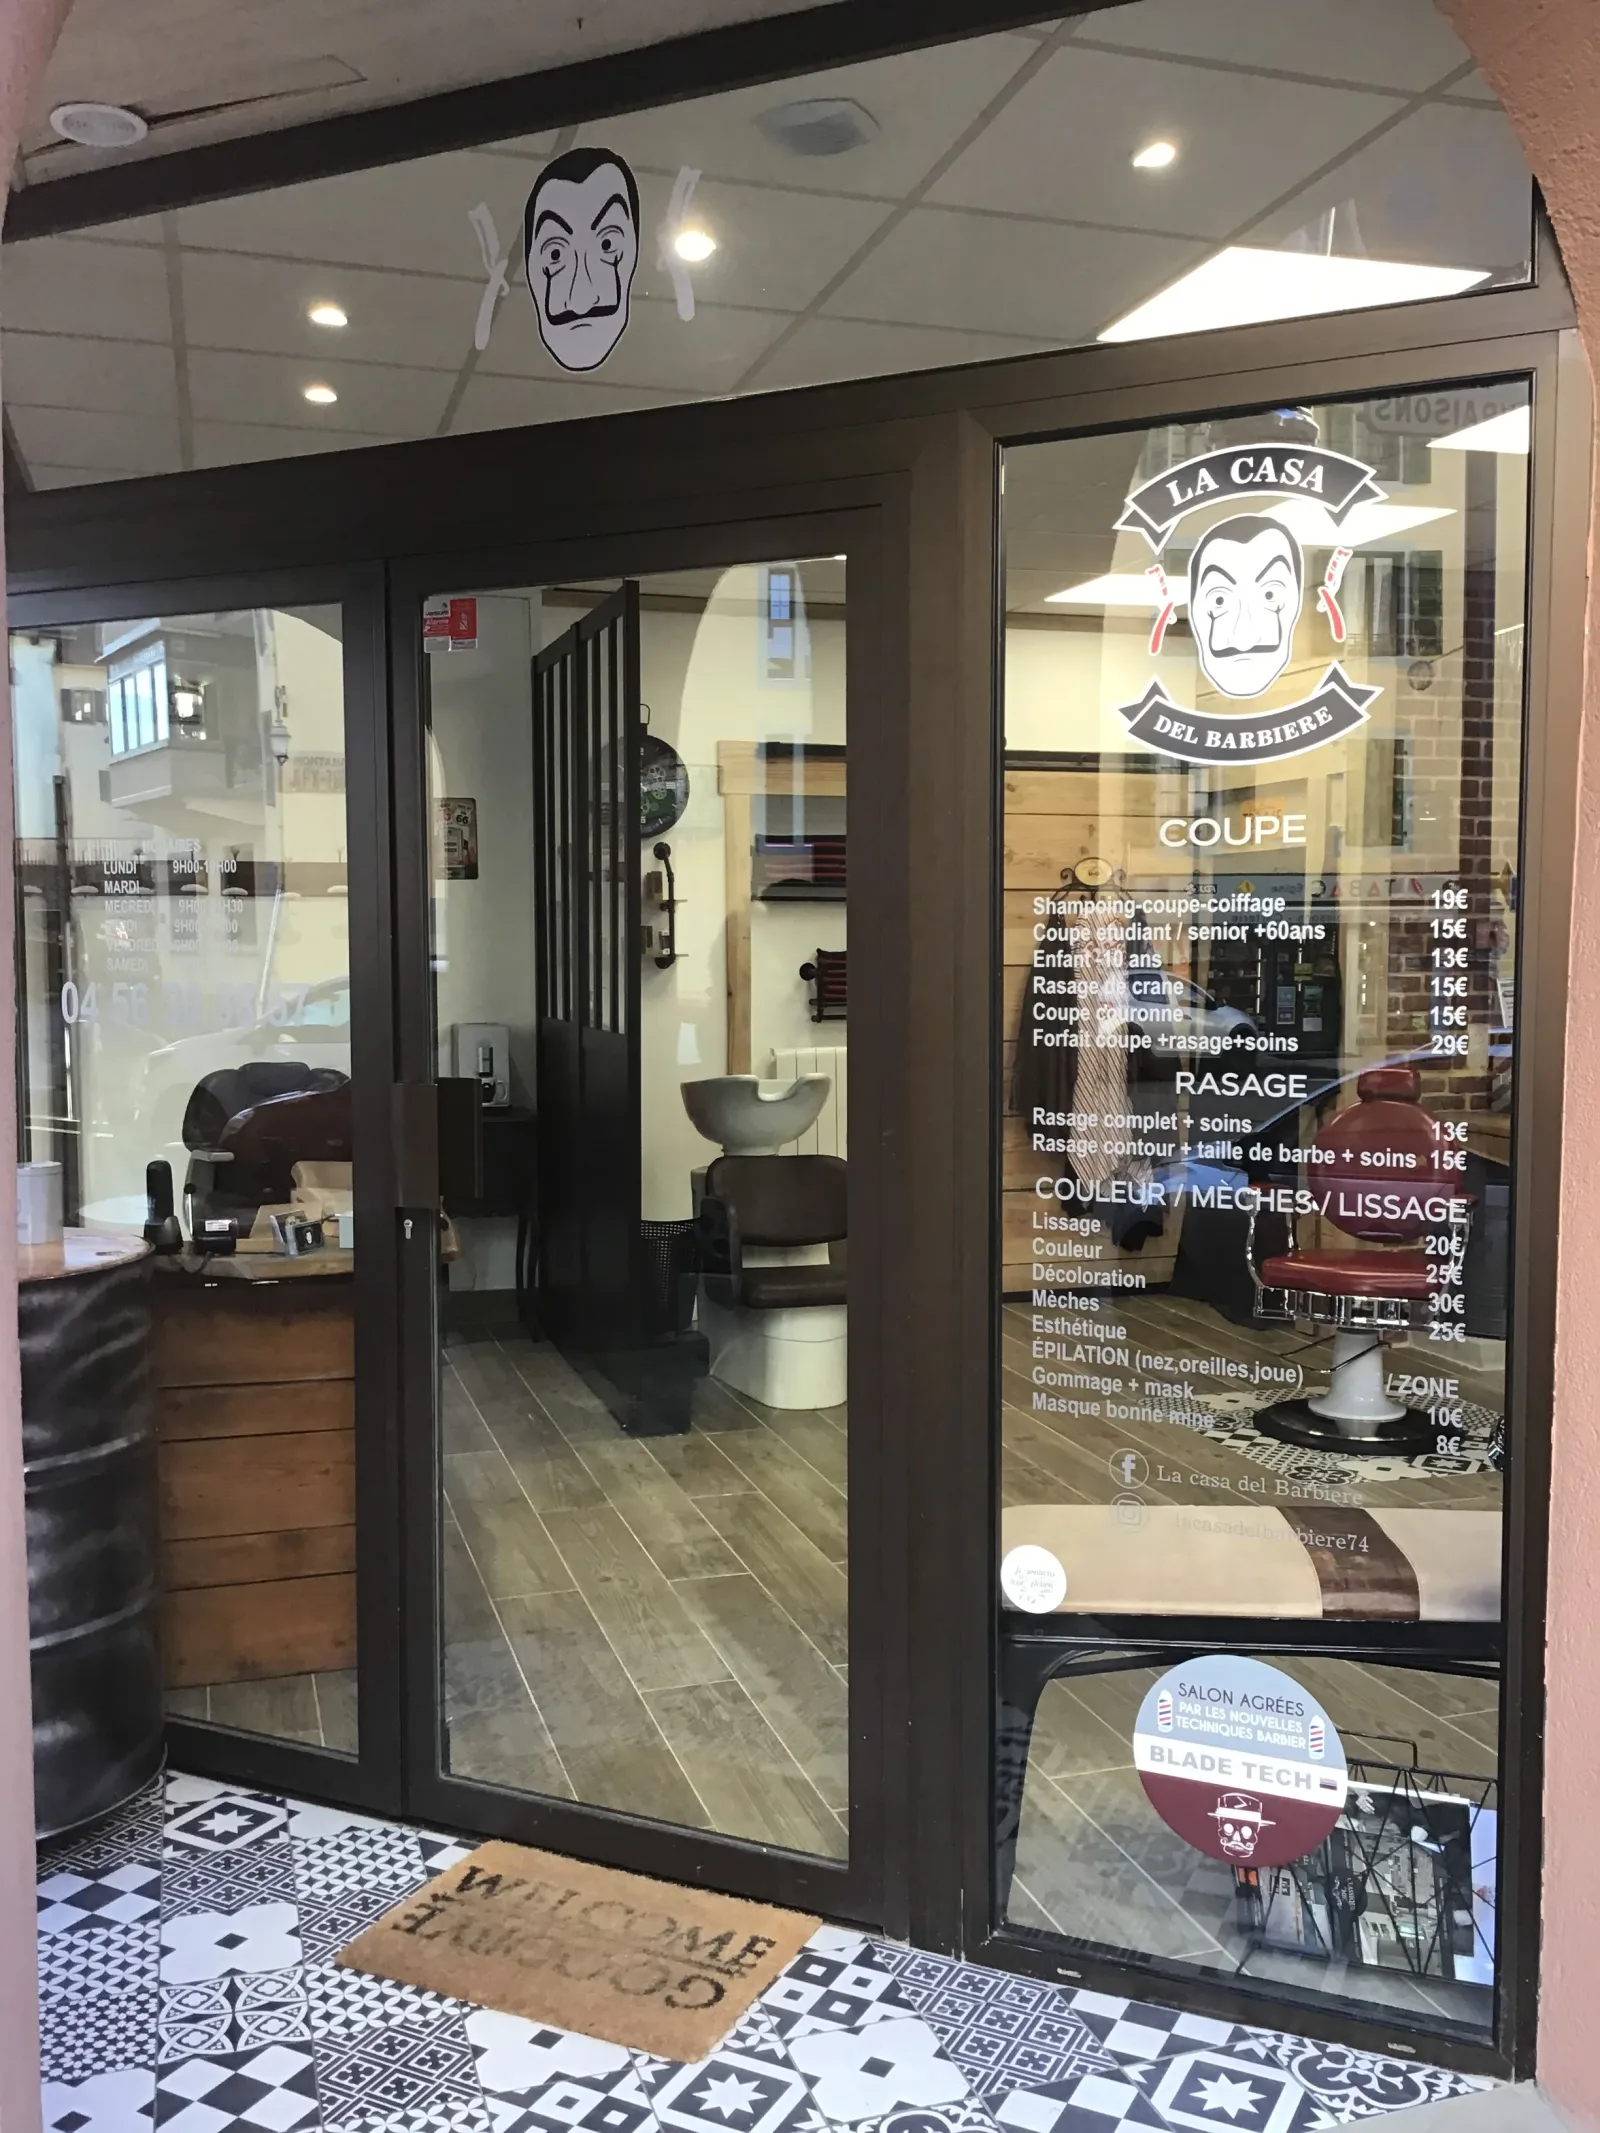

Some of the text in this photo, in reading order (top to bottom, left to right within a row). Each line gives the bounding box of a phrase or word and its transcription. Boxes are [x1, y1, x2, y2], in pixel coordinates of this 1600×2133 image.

[1166, 456, 1325, 507] LA CASA
[1153, 705, 1334, 749] DEL BARBIERE
[1159, 814, 1307, 848] COUPE
[142, 839, 201, 853] HOAIRES
[103, 860, 137, 875] LUNDI
[104, 880, 140, 894] MARDI
[1033, 893, 1286, 918] Shampoing-coupe-coiffage
[1431, 889, 1468, 910] 19€
[1033, 923, 1091, 945] Coupe
[1176, 922, 1183, 941] /
[1188, 923, 1249, 941] senior
[1254, 921, 1326, 940] +60ans
[1430, 918, 1467, 939] 15€
[1033, 949, 1091, 968] Enfant
[1129, 954, 1162, 968] ans
[1431, 947, 1469, 968] 13€
[1033, 976, 1468, 998] Rasage de crane 15€
[61, 981, 99, 1024] 04
[1033, 1002, 1468, 1027] Coupe couronne 15€
[1033, 1029, 1469, 1056] Forfait coupe +rasage+soins 29€
[1176, 1071, 1307, 1098] RASAGE
[1033, 1107, 1468, 1142] Rasage complet + soins 13€
[1033, 1133, 1467, 1171] Rasage contour + taille de barbe + soins 15€
[1035, 1176, 1468, 1224] COULEUR / MÈCHES / LISSAGE
[1032, 1211, 1101, 1237] Lissage
[1032, 1237, 1102, 1259] Couleur
[1425, 1235, 1463, 1256] 20€
[1032, 1263, 1146, 1289] Décoloration
[1426, 1264, 1463, 1285] 25€
[1032, 1289, 1100, 1312] Mèches
[1428, 1292, 1465, 1314] 30€
[1032, 1315, 1127, 1342] Esthétique
[1429, 1321, 1466, 1343] 25€
[1032, 1336, 1304, 1389] ÉPILATION (nez,oreilles,joue)
[1032, 1367, 1195, 1400] Gommage + mask
[1386, 1373, 1459, 1399] / ZONE
[1032, 1392, 1101, 1418] Masque
[1106, 1400, 1163, 1423] bonne
[1427, 1406, 1463, 1428] 10€
[1436, 1436, 1461, 1456] 8€
[1157, 1465, 1363, 1506] La casa del Barbiere
[1178, 1682, 1305, 1717] SALON AGRÉES
[1179, 1701, 1303, 1734] PAR LES NOUVELLES
[1176, 1715, 1307, 1750] TECHNIQUES BARBIER
[1150, 1744, 1312, 1790] BLADE TECH
[456, 1865, 777, 1970] WELCOME
